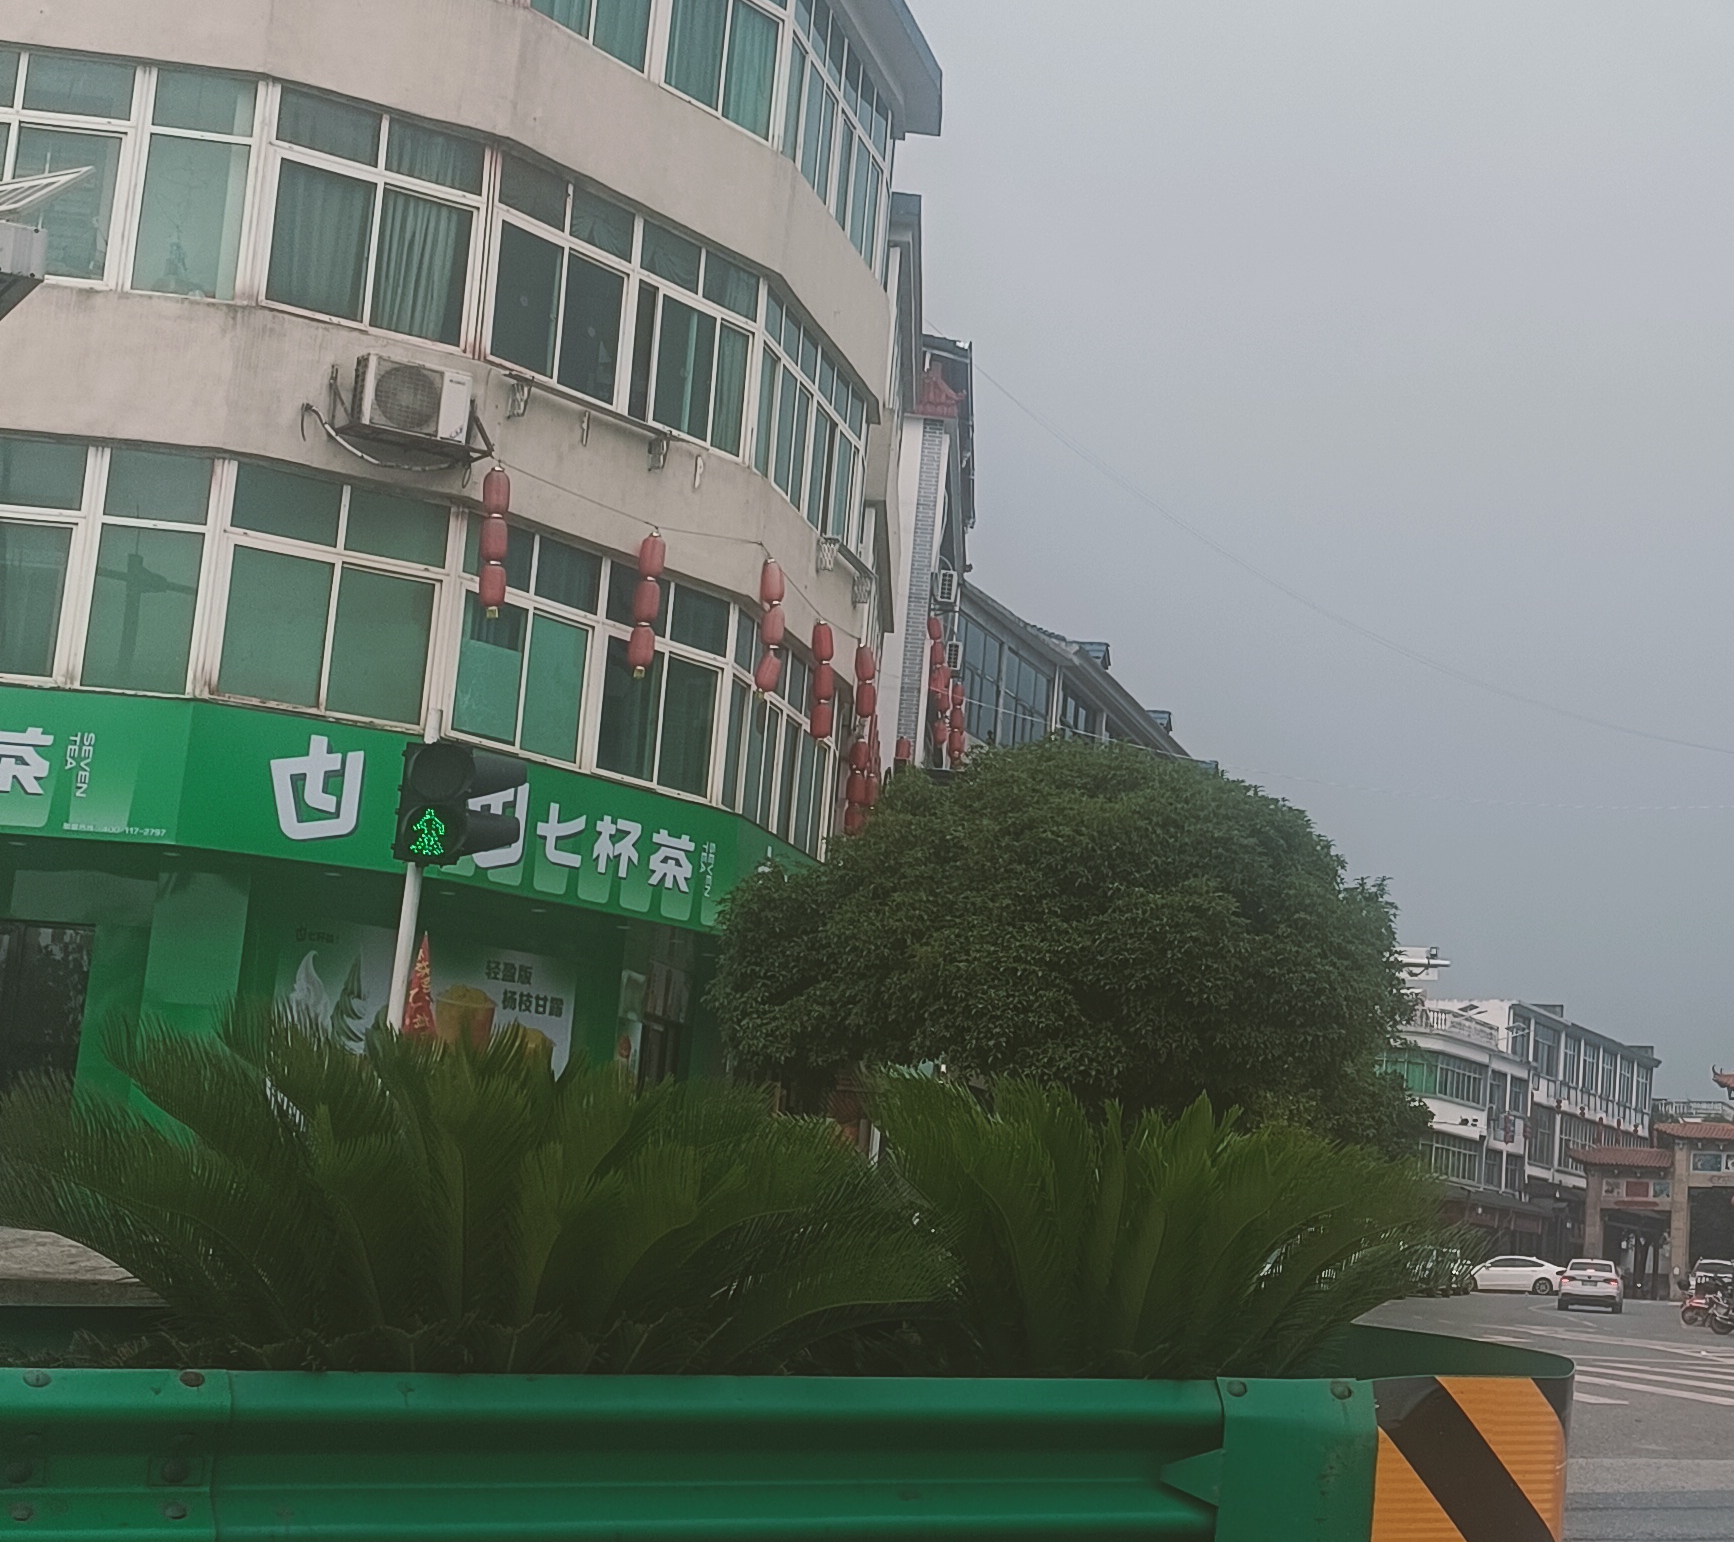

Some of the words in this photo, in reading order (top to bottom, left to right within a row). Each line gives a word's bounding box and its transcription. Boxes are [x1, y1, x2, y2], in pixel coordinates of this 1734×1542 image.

[65, 732, 82, 770] TEA
[75, 732, 96, 798] SEVEN
[536, 802, 696, 893] 七杯茶
[703, 842, 716, 897] SEVEN
[485, 959, 534, 986] 轻盈版
[501, 989, 565, 1019] 杨枝甘露
